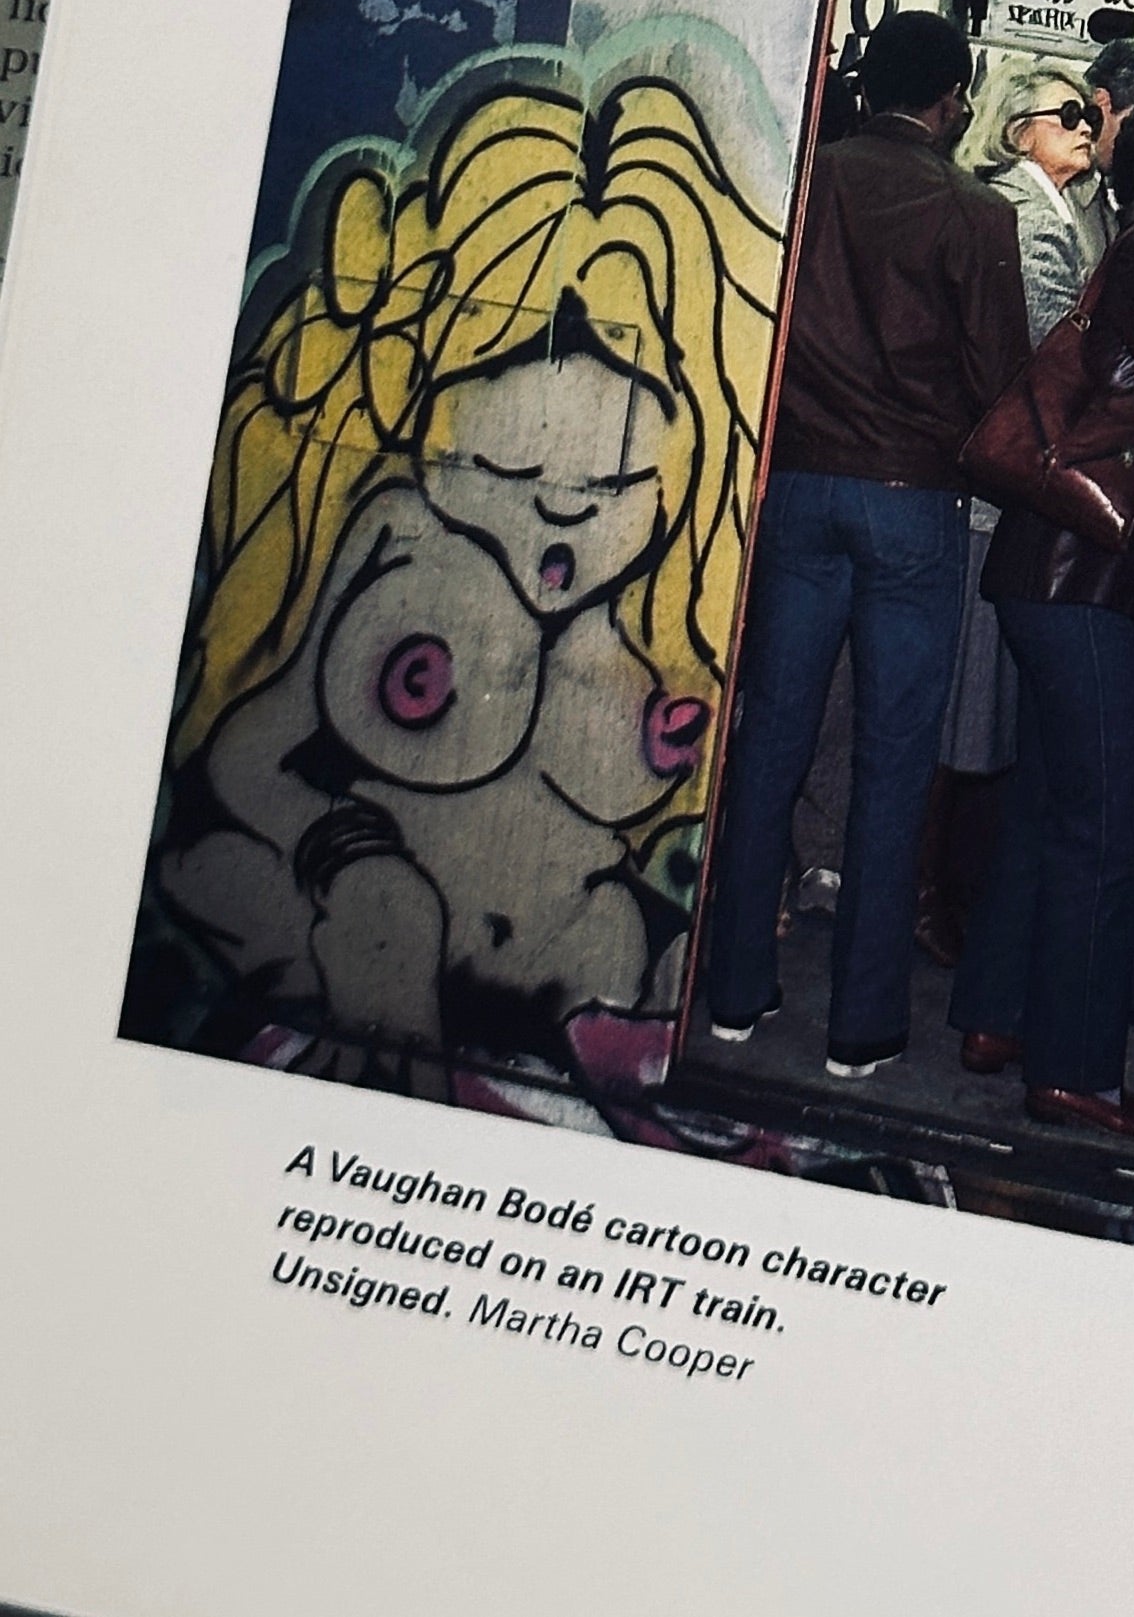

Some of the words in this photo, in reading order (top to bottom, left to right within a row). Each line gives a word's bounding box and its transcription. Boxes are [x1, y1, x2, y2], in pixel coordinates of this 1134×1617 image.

[276, 1206, 495, 1271] reproduced
[499, 1253, 548, 1282] on
[556, 1265, 605, 1295] an
[612, 1268, 687, 1310] IRT
[691, 1288, 785, 1334] train.
[284, 1145, 316, 1178] A
[330, 1150, 488, 1213] Vaughan
[496, 1187, 596, 1235] Bodé
[603, 1217, 751, 1269] cartoon
[760, 1246, 948, 1307] character
[271, 1252, 452, 1319] Unsigned.
[467, 1294, 604, 1351] Martha
[616, 1325, 756, 1381] Cooper
